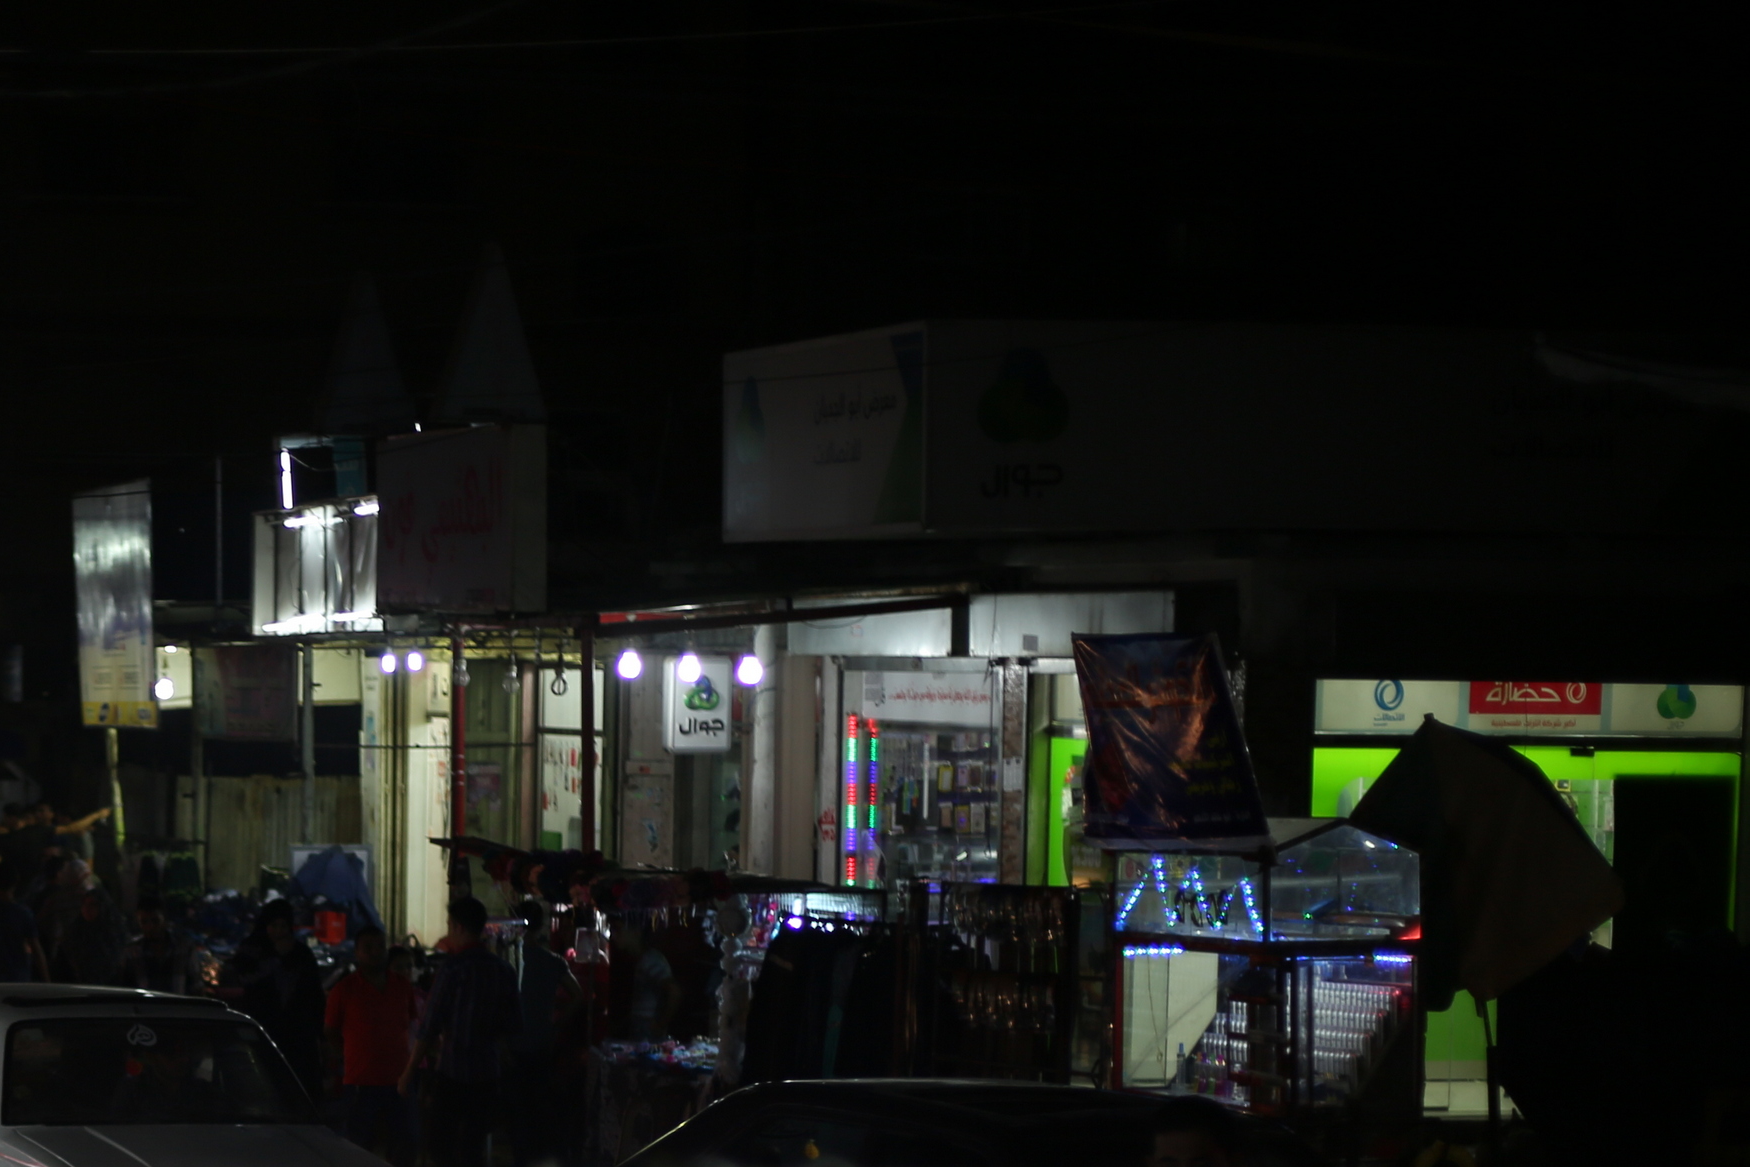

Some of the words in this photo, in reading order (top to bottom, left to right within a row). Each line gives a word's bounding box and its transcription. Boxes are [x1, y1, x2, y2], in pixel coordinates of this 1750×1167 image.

[981, 462, 1063, 499] جوال
[1486, 682, 1561, 705] حضارة
[679, 717, 724, 737] جوال
